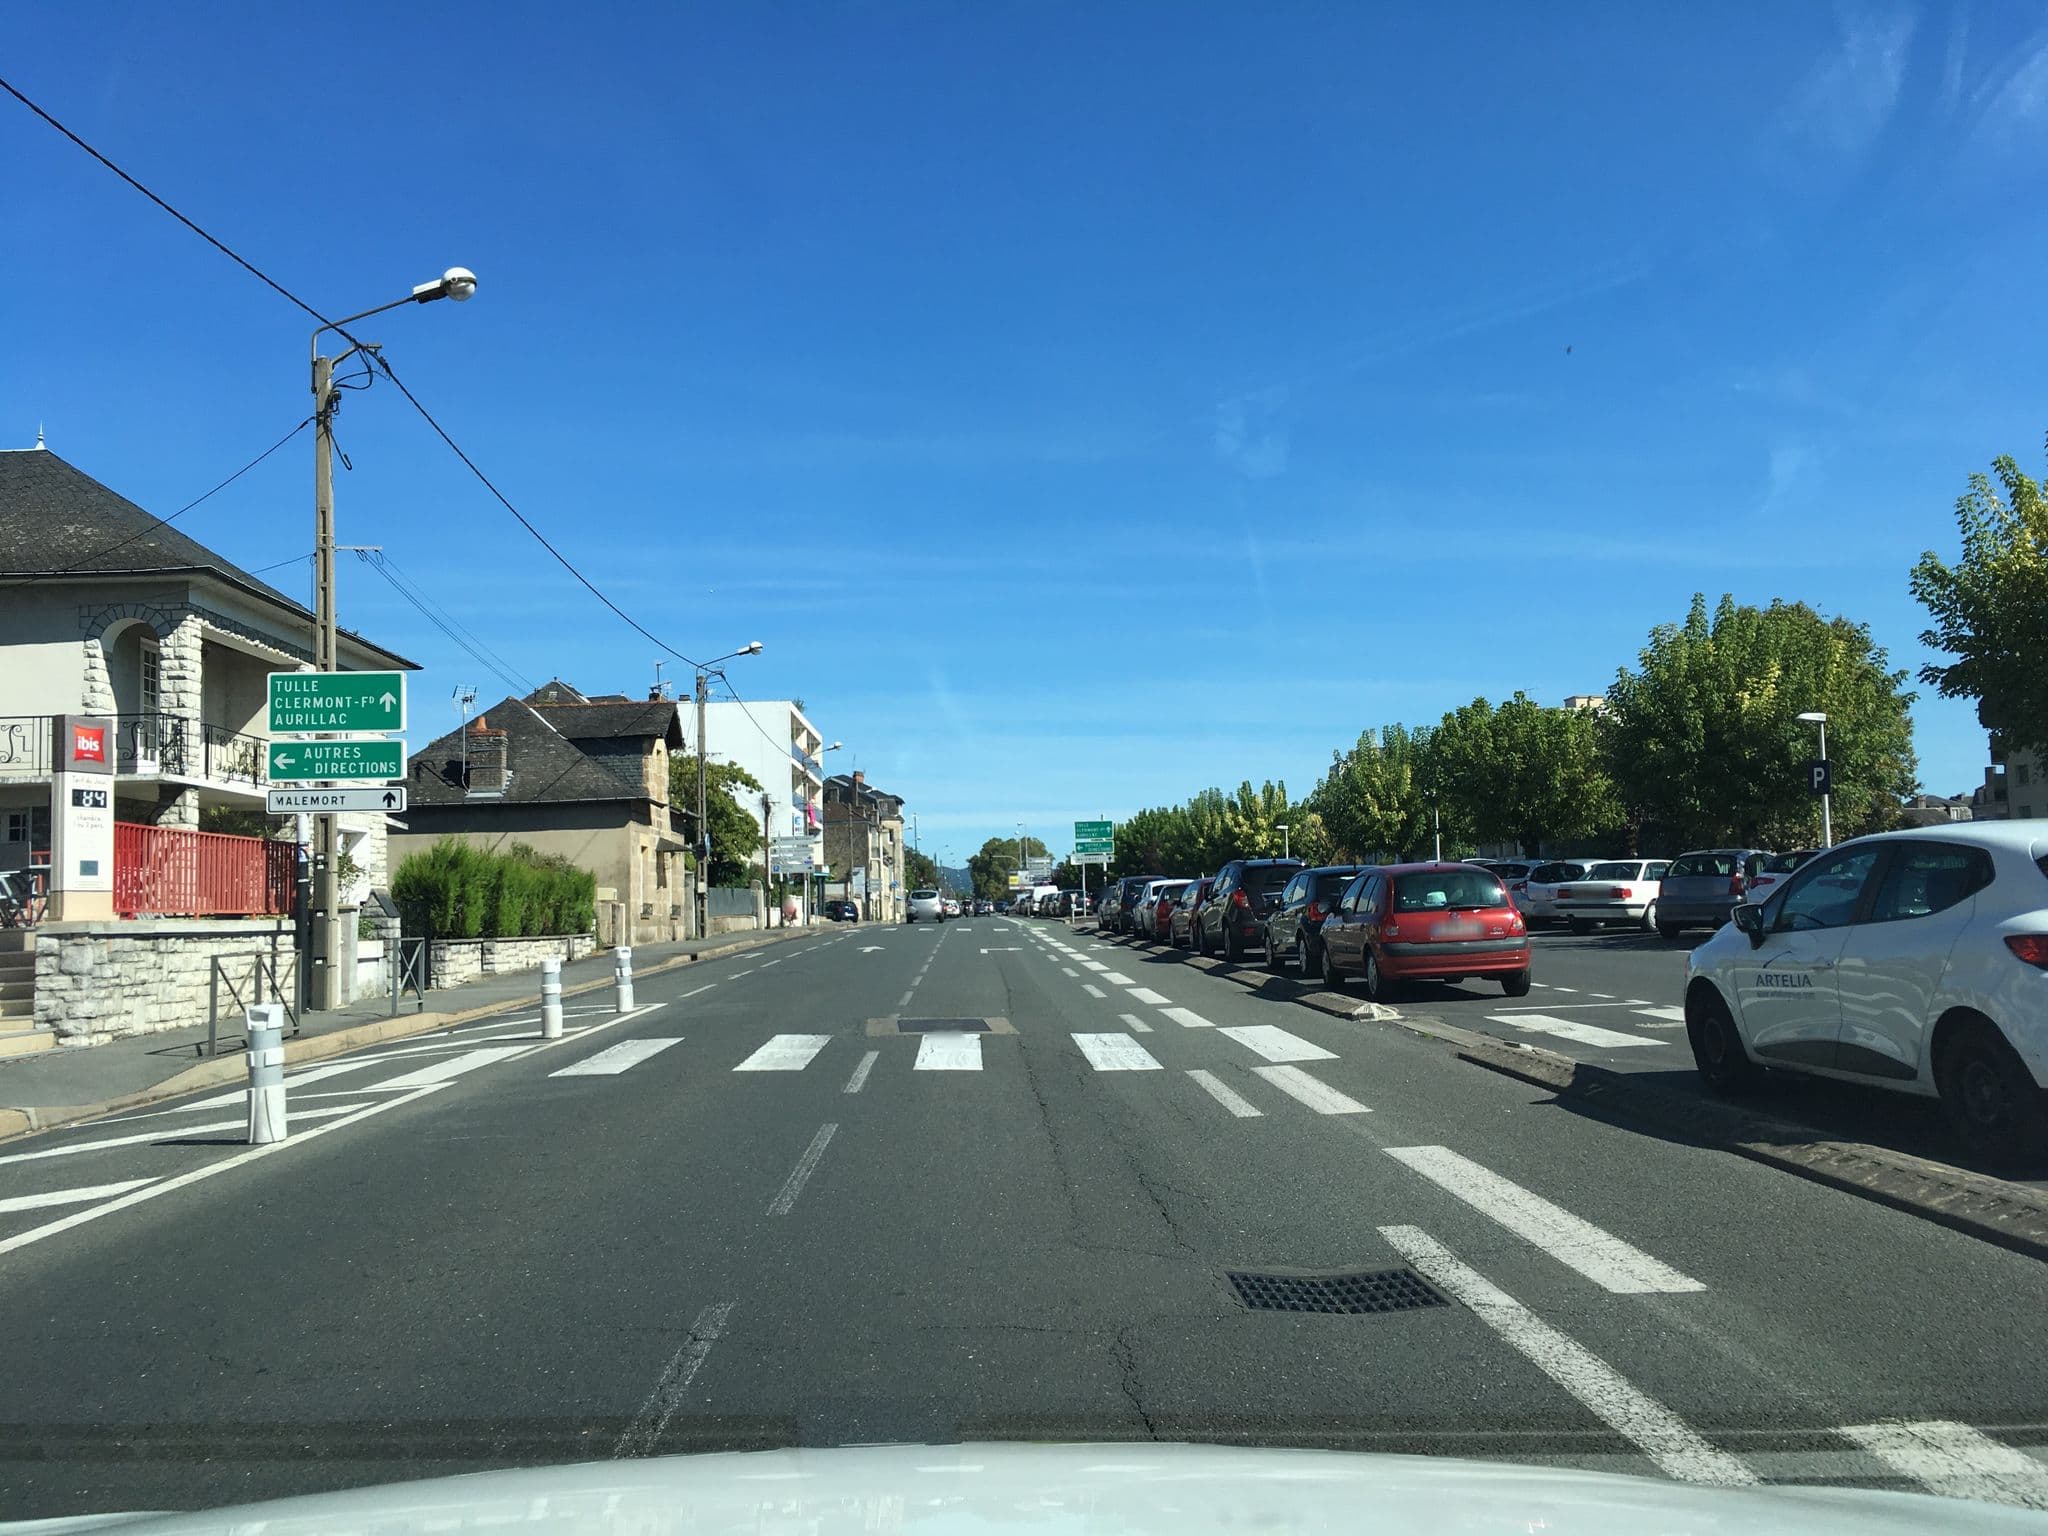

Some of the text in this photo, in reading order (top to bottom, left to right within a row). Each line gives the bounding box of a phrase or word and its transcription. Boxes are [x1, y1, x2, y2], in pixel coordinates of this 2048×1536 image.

[275, 680, 319, 692] TULLE
[274, 713, 347, 725] AURILLAC
[77, 736, 100, 751] ibis
[304, 747, 361, 759] AUTRES
[315, 761, 397, 774] DIRECTIONS
[1813, 767, 1825, 789] P
[82, 791, 105, 807] 84
[276, 795, 346, 806] MALEMORT
[1756, 974, 1813, 987] ARTELIA
